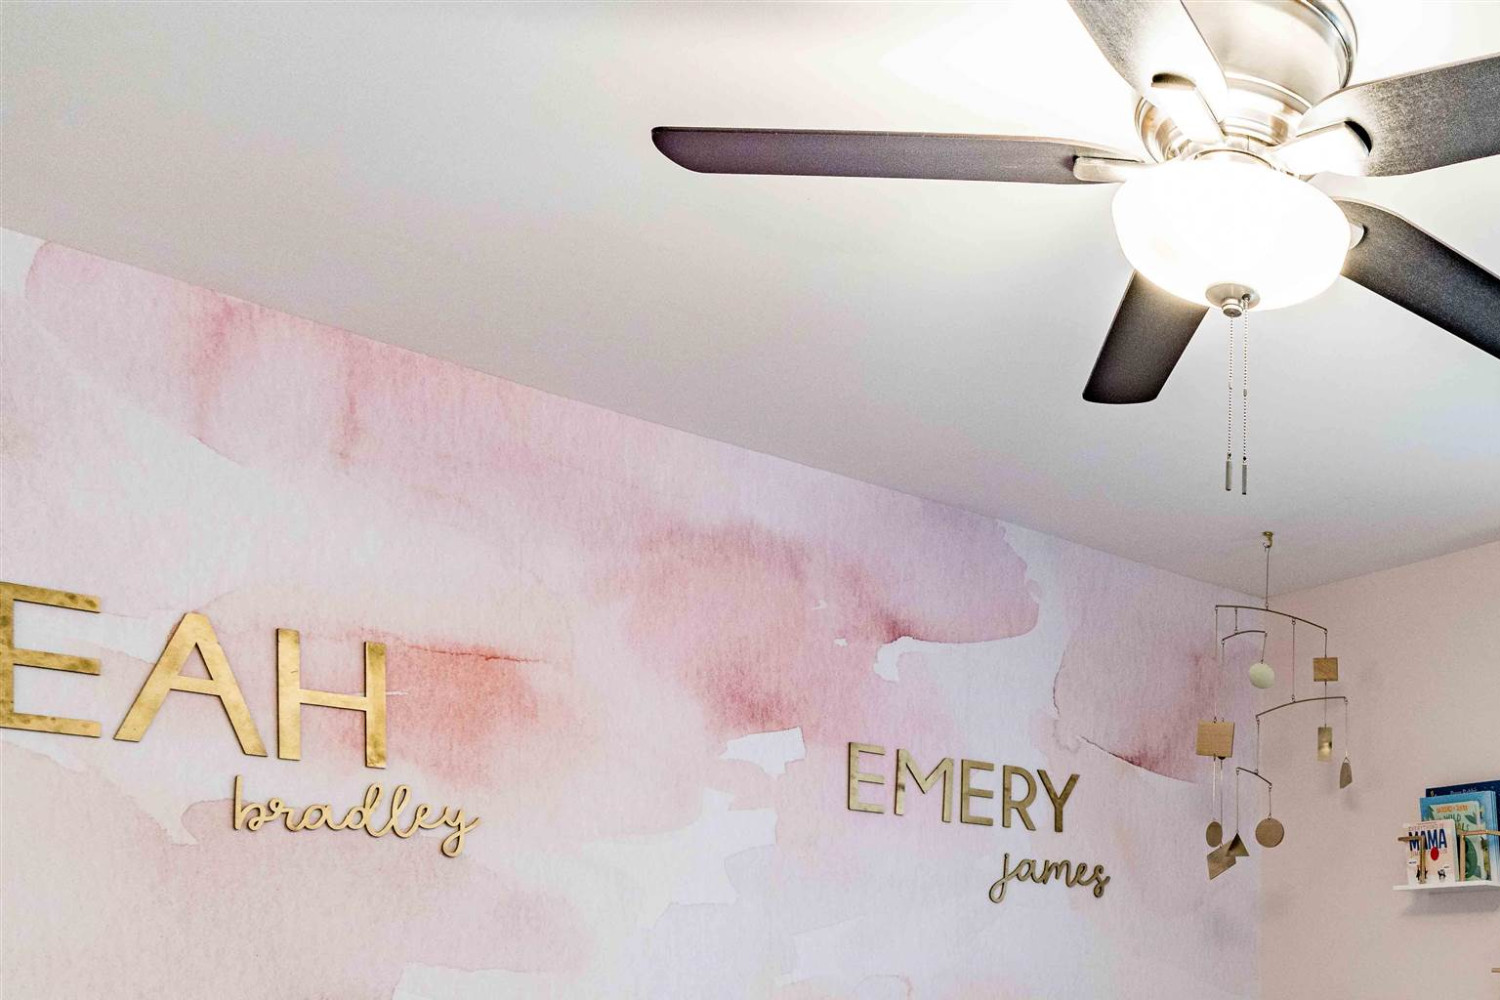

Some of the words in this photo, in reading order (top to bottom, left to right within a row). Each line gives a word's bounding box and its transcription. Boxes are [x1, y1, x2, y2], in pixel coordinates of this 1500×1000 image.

[233, 774, 480, 858] bradley
[847, 741, 1080, 833] EMERY
[988, 852, 1111, 904] james
